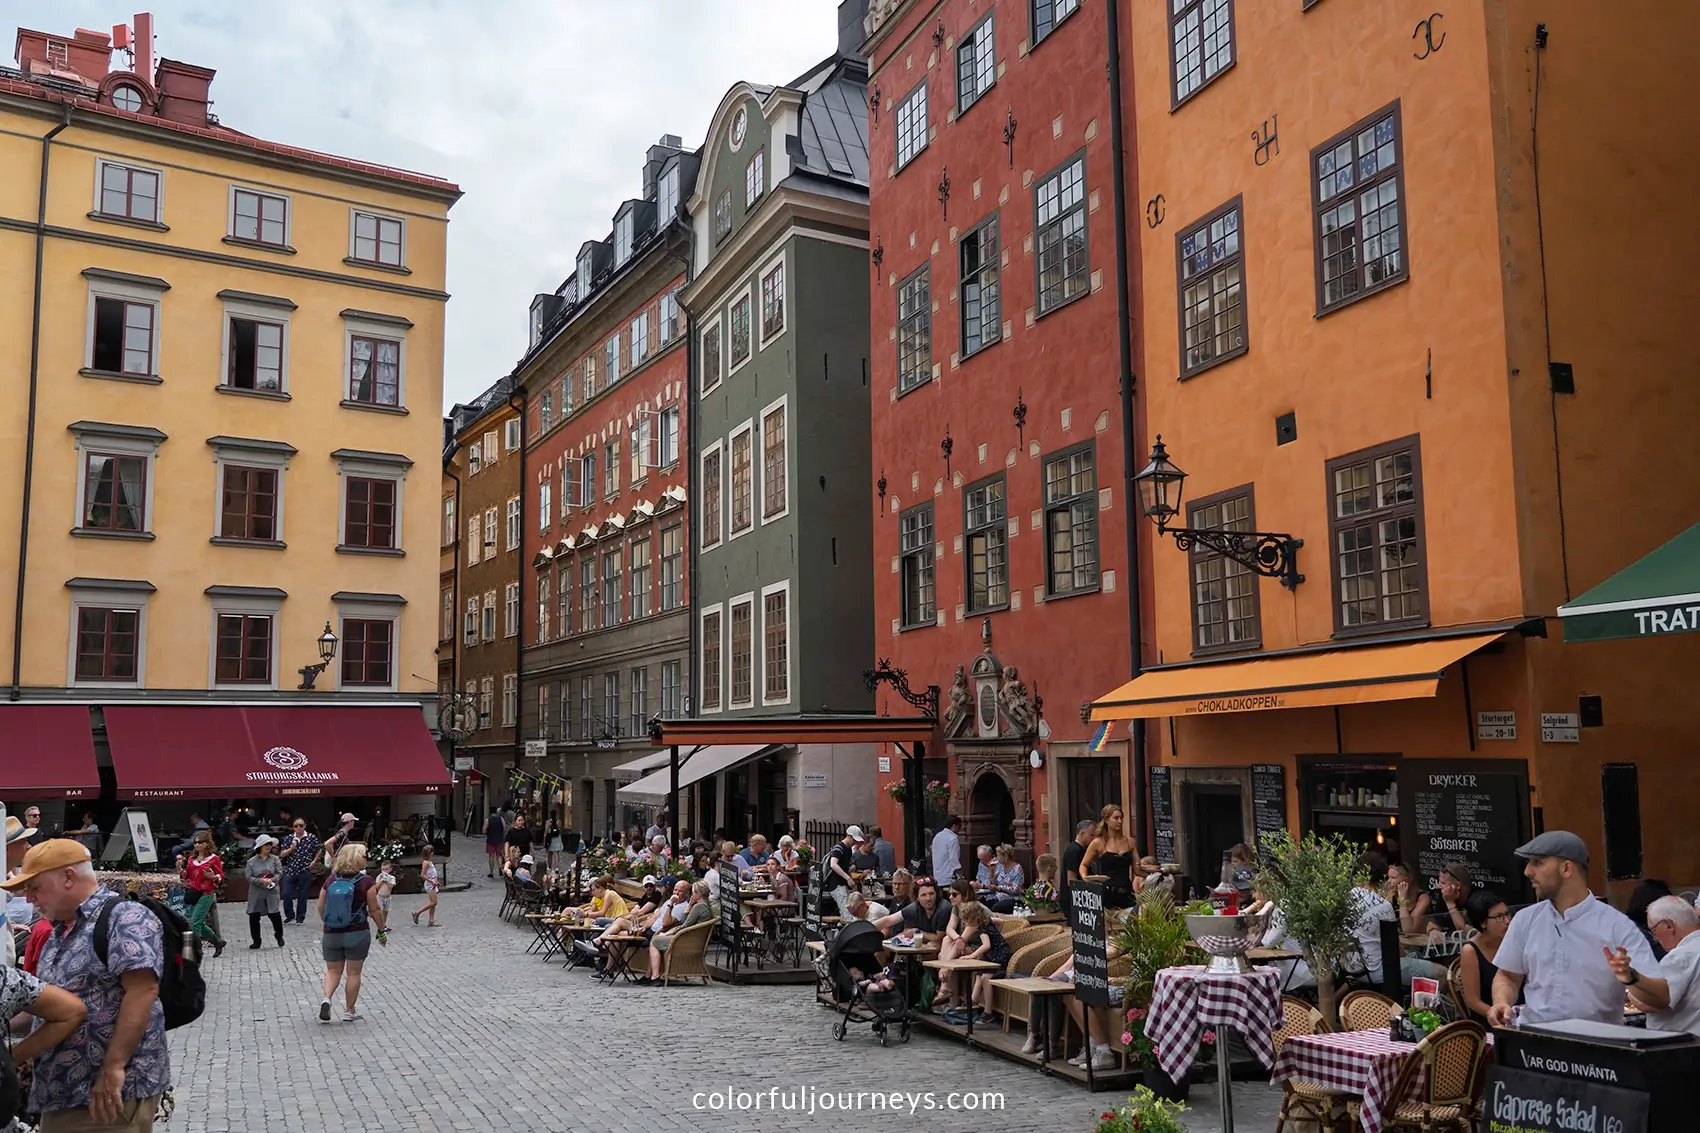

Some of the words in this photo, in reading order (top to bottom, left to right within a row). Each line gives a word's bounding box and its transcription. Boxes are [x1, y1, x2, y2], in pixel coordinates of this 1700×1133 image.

[1634, 606, 1700, 634] TRAT
[1481, 714, 1513, 724] Stortorget
[1543, 716, 1568, 727] Solgränd
[1495, 728, 1515, 738] 20-18
[1544, 731, 1554, 740] 1-3
[246, 771, 339, 780] STORTORGSKÄLLAREN
[1428, 774, 1477, 788] DRYCKER
[1430, 837, 1478, 853] SÖTSAKER
[1078, 911, 1097, 930] MENY
[1520, 1049, 1544, 1069] VAR
[1546, 1059, 1568, 1073] GOD
[1571, 1063, 1618, 1082] INVÄNTA
[1494, 1080, 1552, 1129] Caprese
[1556, 1097, 1598, 1133] Salad
